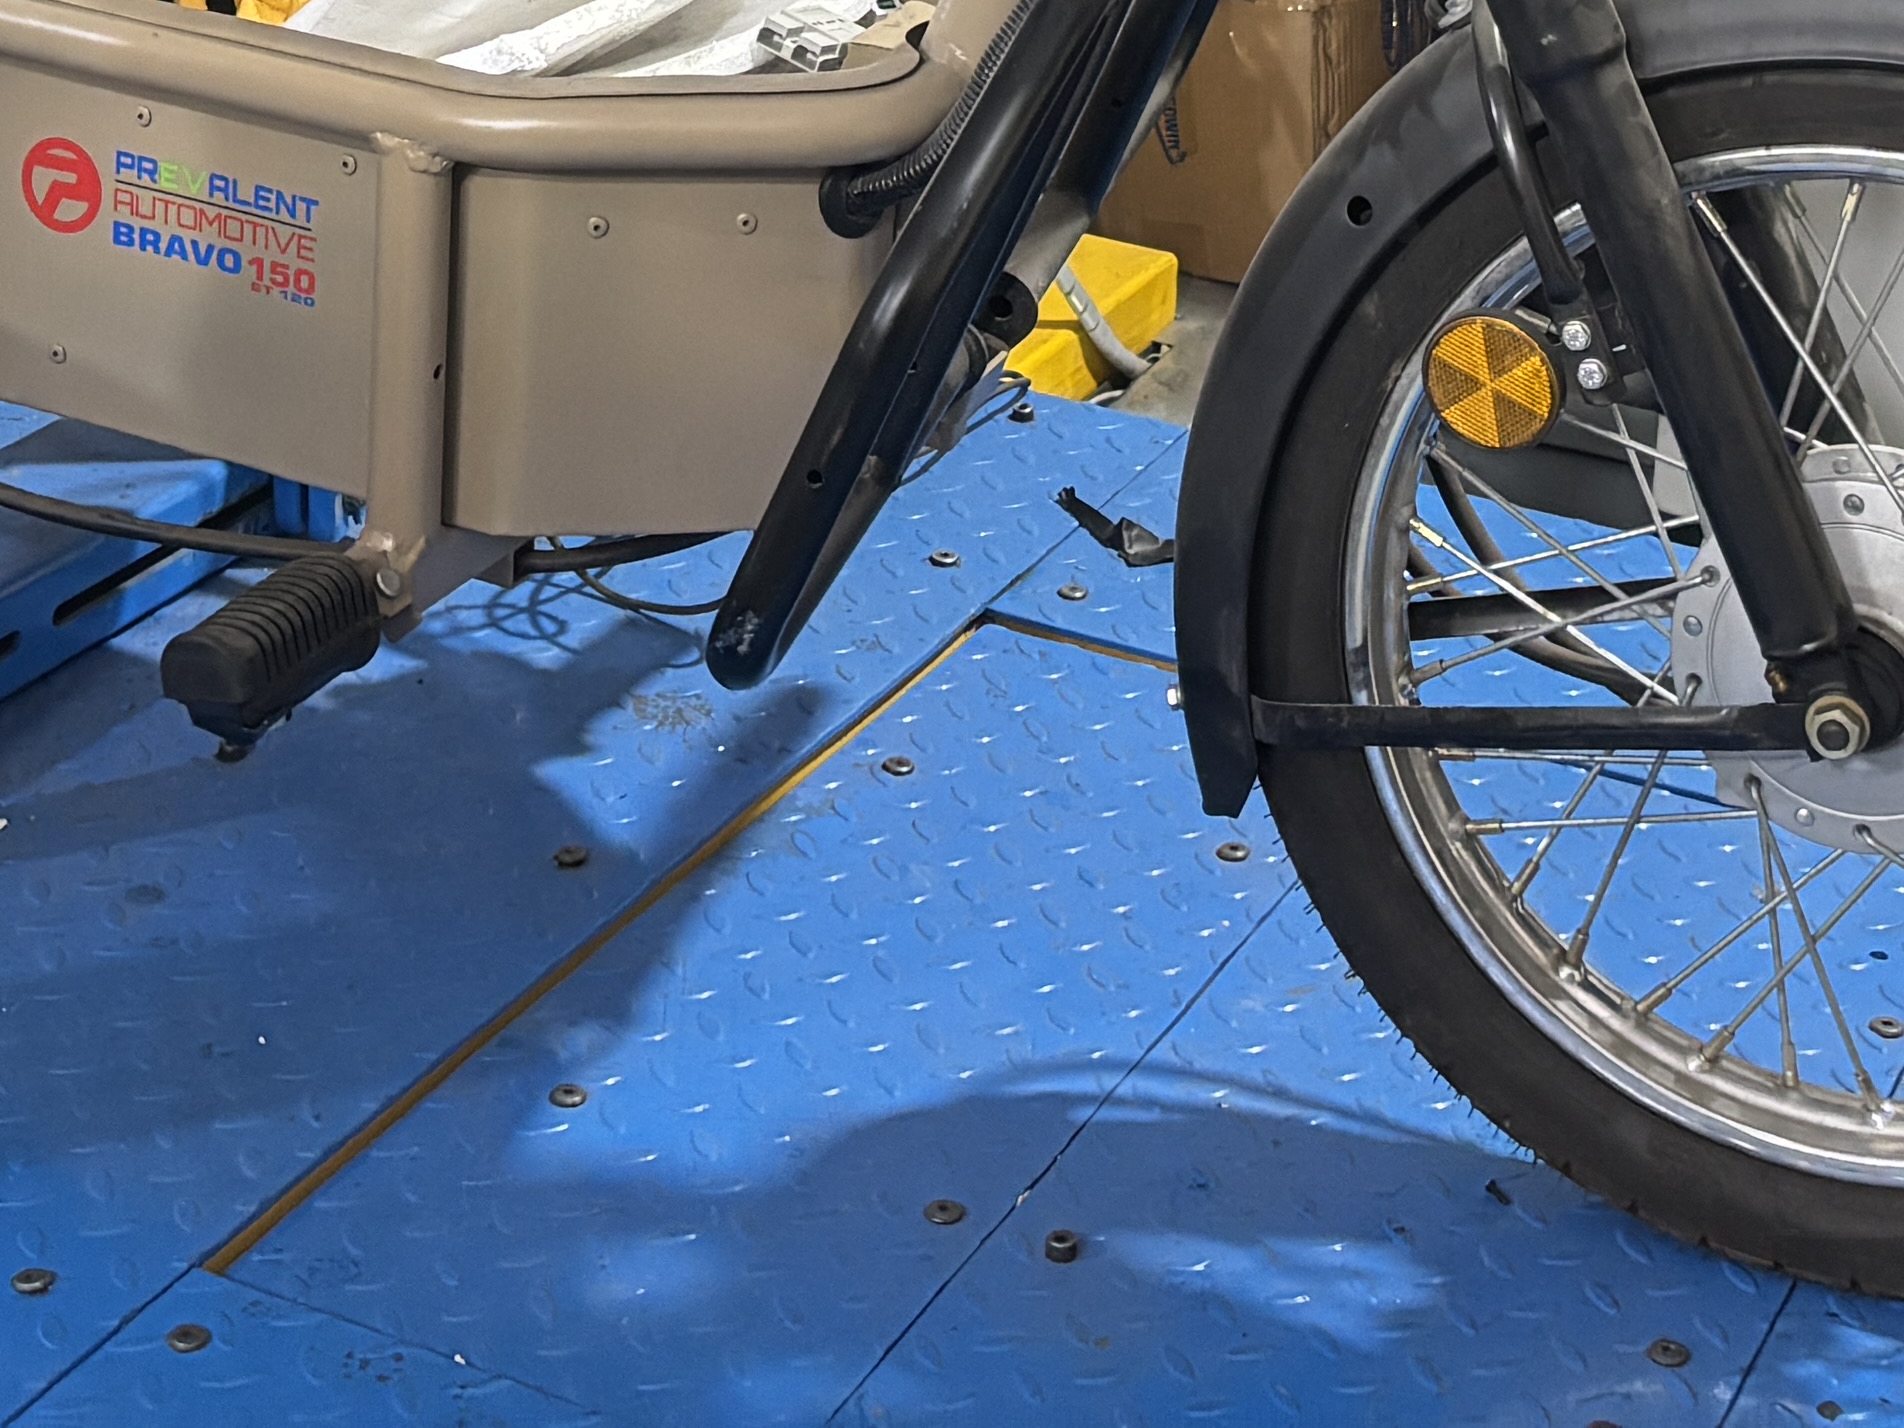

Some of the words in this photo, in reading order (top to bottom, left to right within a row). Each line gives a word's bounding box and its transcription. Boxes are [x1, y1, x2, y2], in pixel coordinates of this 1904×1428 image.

[114, 149, 320, 225] PREVALENT
[112, 220, 243, 275] BRAVO
[248, 256, 317, 296] 150
[113, 187, 318, 264] AUTOMOTIVE
[279, 290, 316, 308] 120
